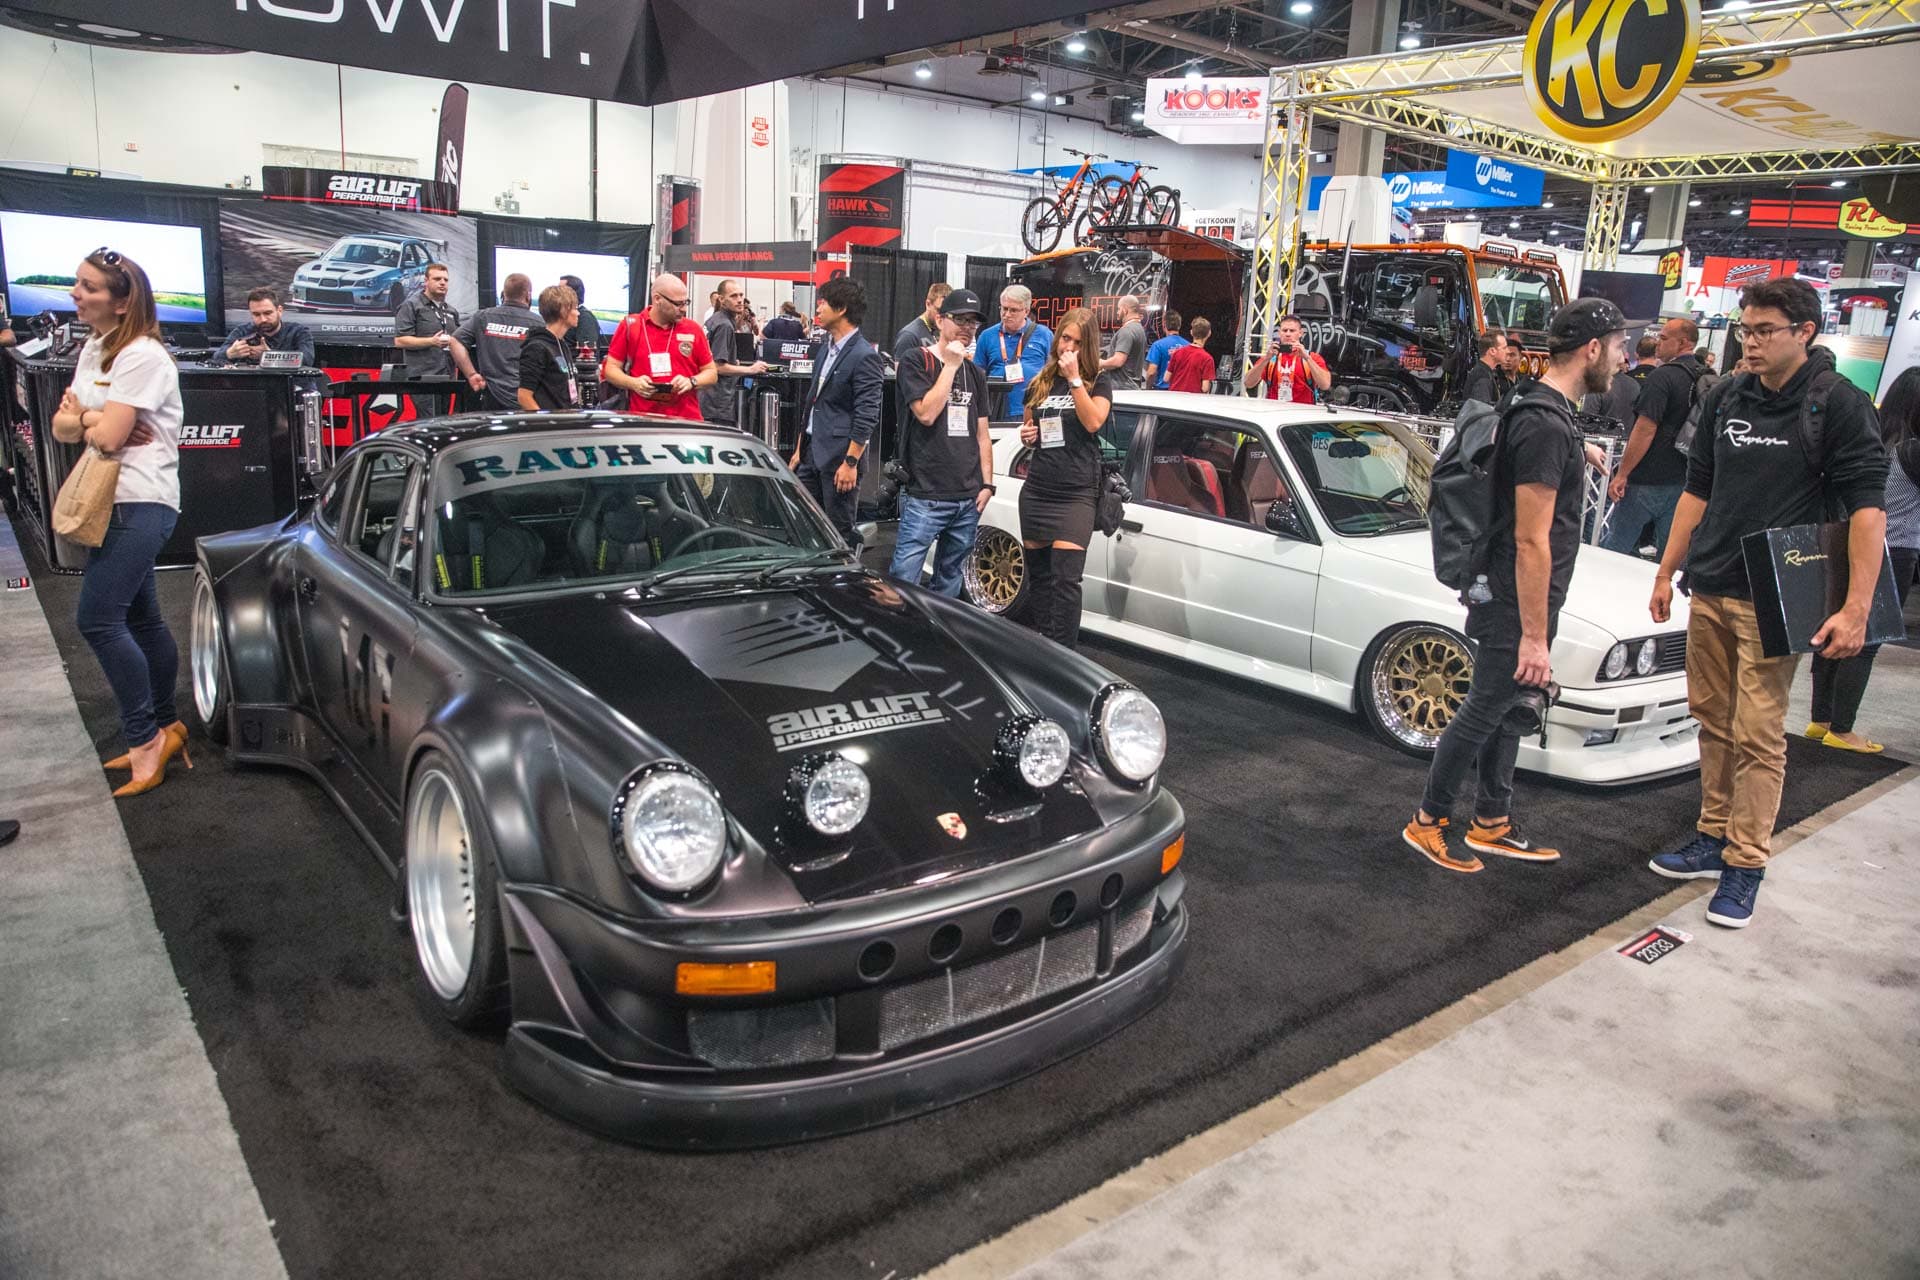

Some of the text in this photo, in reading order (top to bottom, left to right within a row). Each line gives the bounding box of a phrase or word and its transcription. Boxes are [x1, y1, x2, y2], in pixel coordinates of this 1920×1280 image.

[1548, 0, 1668, 119] KC
[1166, 88, 1262, 110] KOOKS
[1492, 165, 1513, 183] Miller
[377, 179, 422, 197] LIFT
[1412, 181, 1444, 195] Miller
[827, 198, 868, 211] HAWK
[692, 250, 774, 262] HAWK PERFORMANCE
[200, 425, 245, 438] LIFT
[852, 691, 931, 720] LIFT
[788, 711, 923, 745] PERFORMANCE
